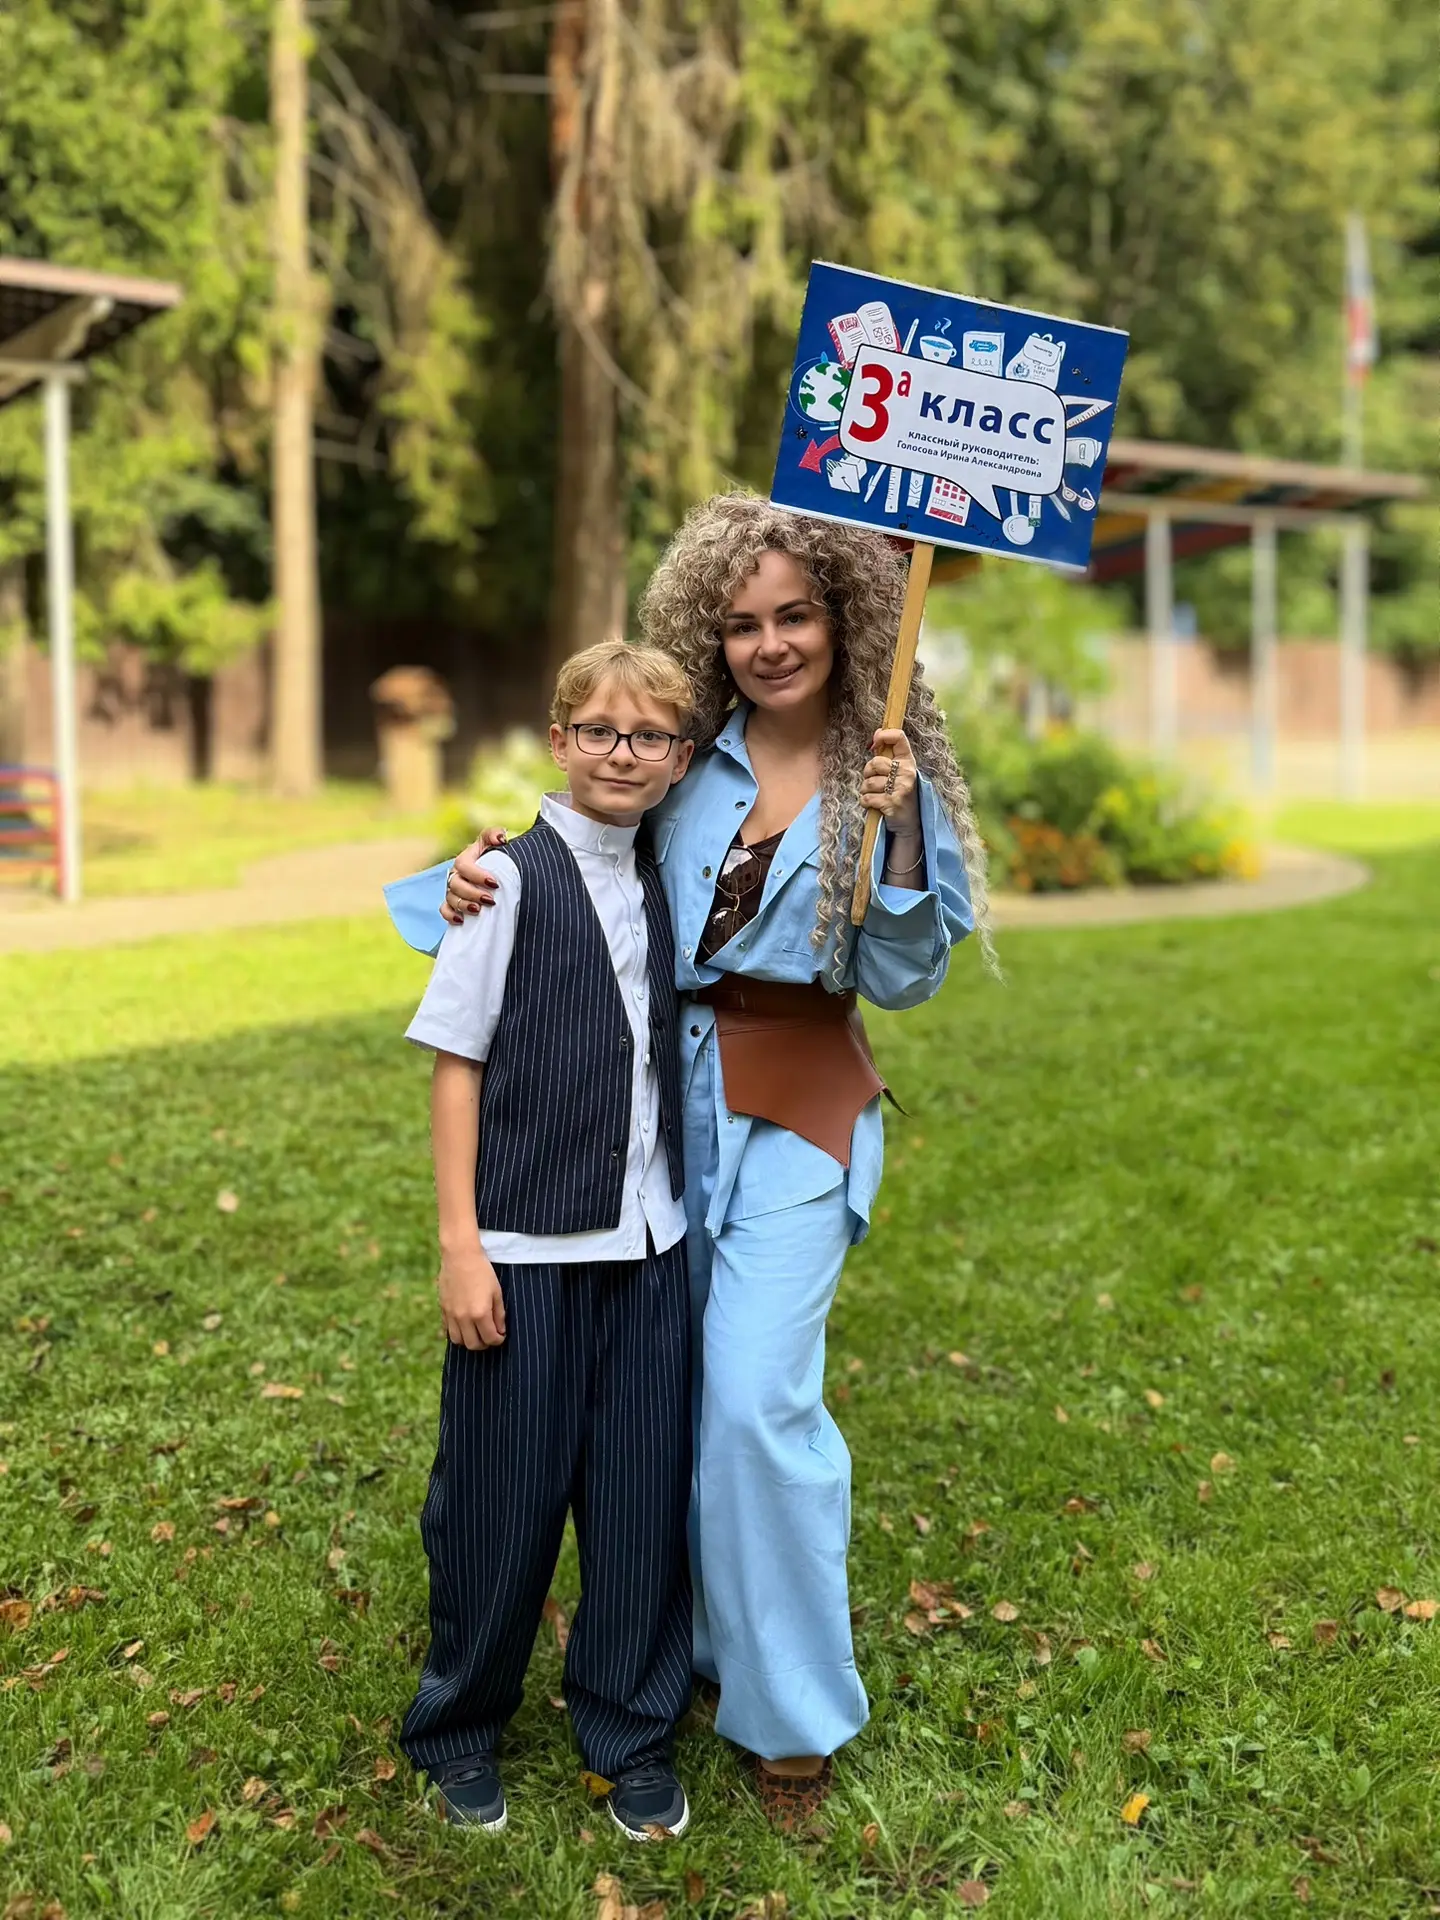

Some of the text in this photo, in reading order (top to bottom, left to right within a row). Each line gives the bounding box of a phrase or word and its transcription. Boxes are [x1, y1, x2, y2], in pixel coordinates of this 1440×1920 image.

[919, 391, 1056, 445] класс
[896, 440, 1042, 479] Голосова Ирина Александровна
[908, 430, 1040, 466] классный руководитель:
